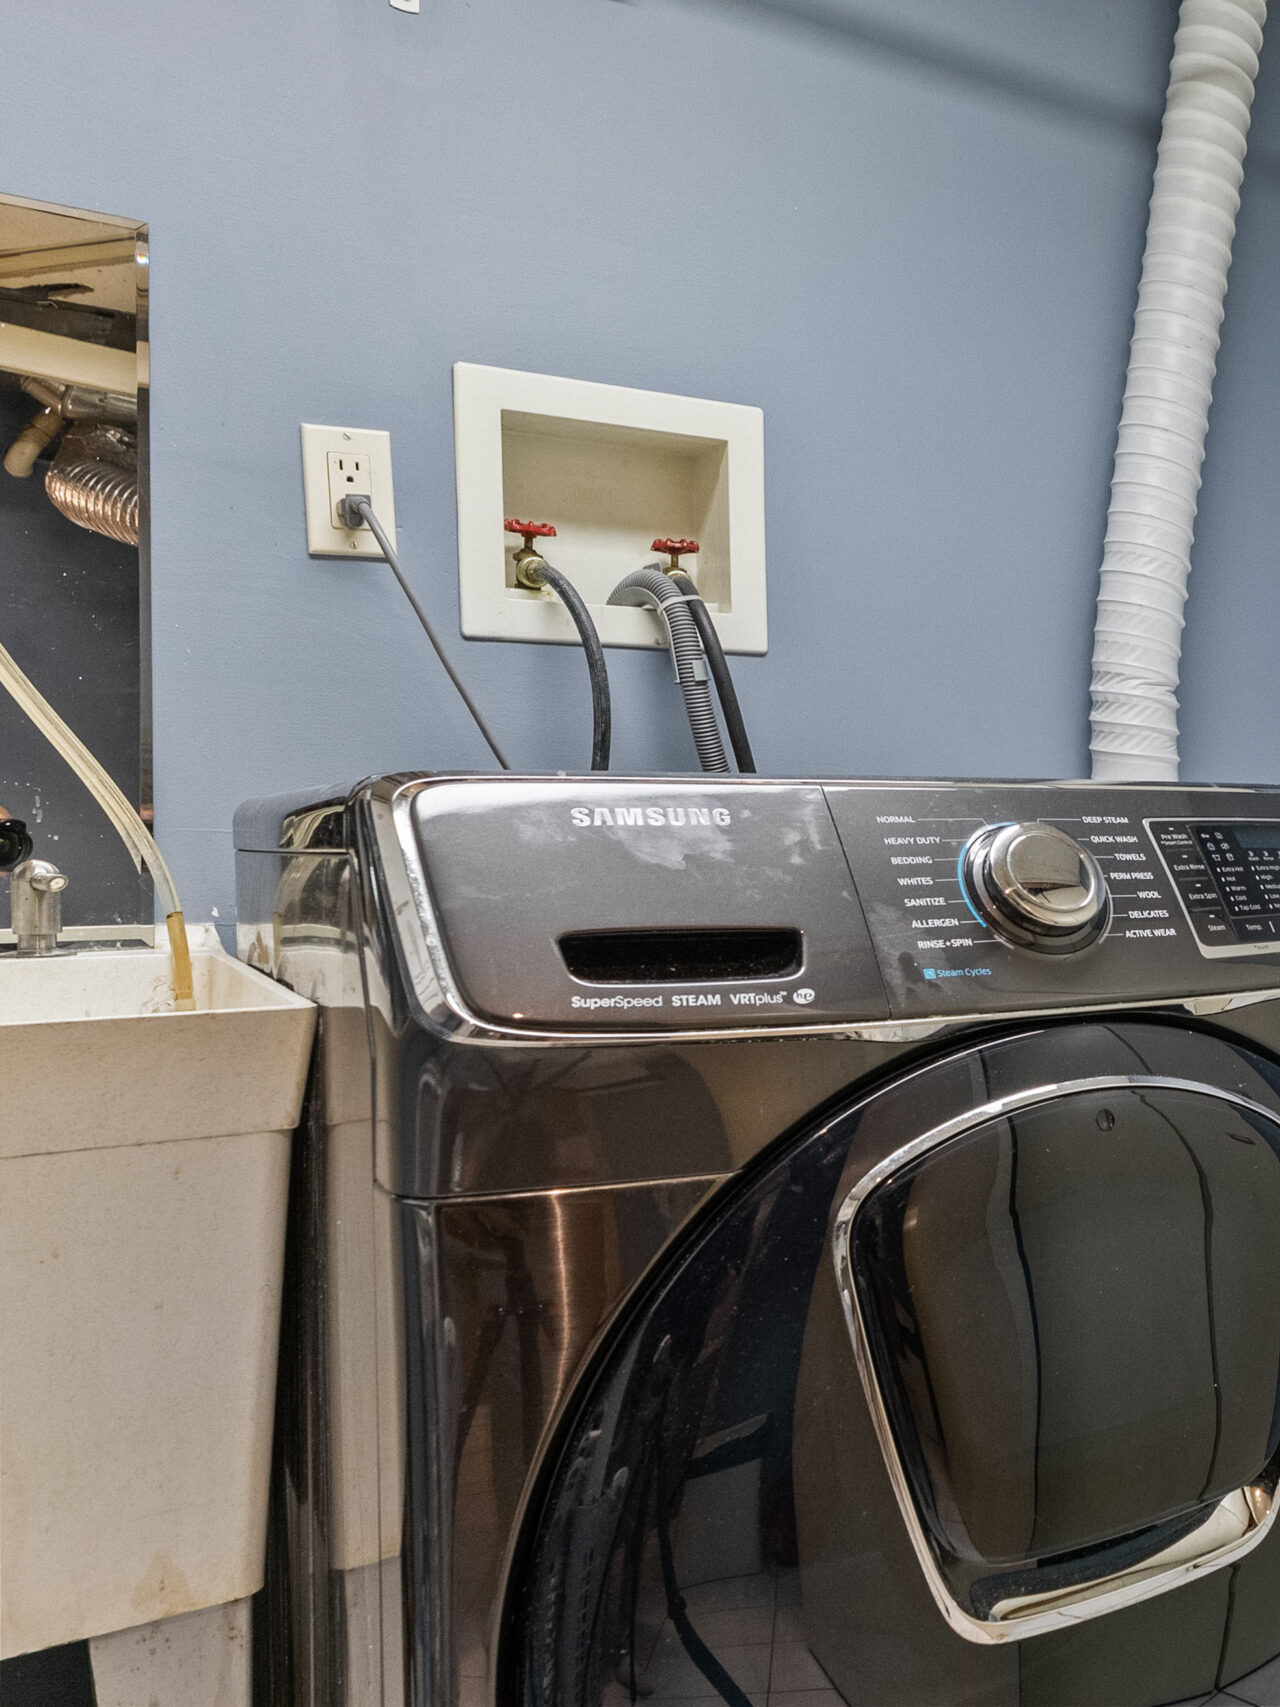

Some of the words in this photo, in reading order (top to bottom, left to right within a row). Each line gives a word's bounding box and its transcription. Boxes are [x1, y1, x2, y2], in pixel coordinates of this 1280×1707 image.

[570, 807, 731, 827] SAMSUNG
[884, 837, 914, 845] HEAVY
[916, 836, 940, 844] DUTY
[1091, 835, 1114, 843] QUICK
[891, 856, 933, 864] BEDDING
[1110, 872, 1131, 880] PERM
[1131, 872, 1154, 880] PRESS
[897, 877, 933, 886] WHITES
[1137, 891, 1161, 899] WOOL
[904, 897, 947, 907] SANITIZE
[1128, 909, 1169, 918] DELICATES
[912, 918, 959, 928] ALLERGEN
[1126, 929, 1153, 938] ACTIVE
[1153, 928, 1177, 937] WEAR
[965, 968, 992, 976] Cycles
[571, 994, 663, 1009] SuperSpeed
[672, 994, 722, 1006] STEAM
